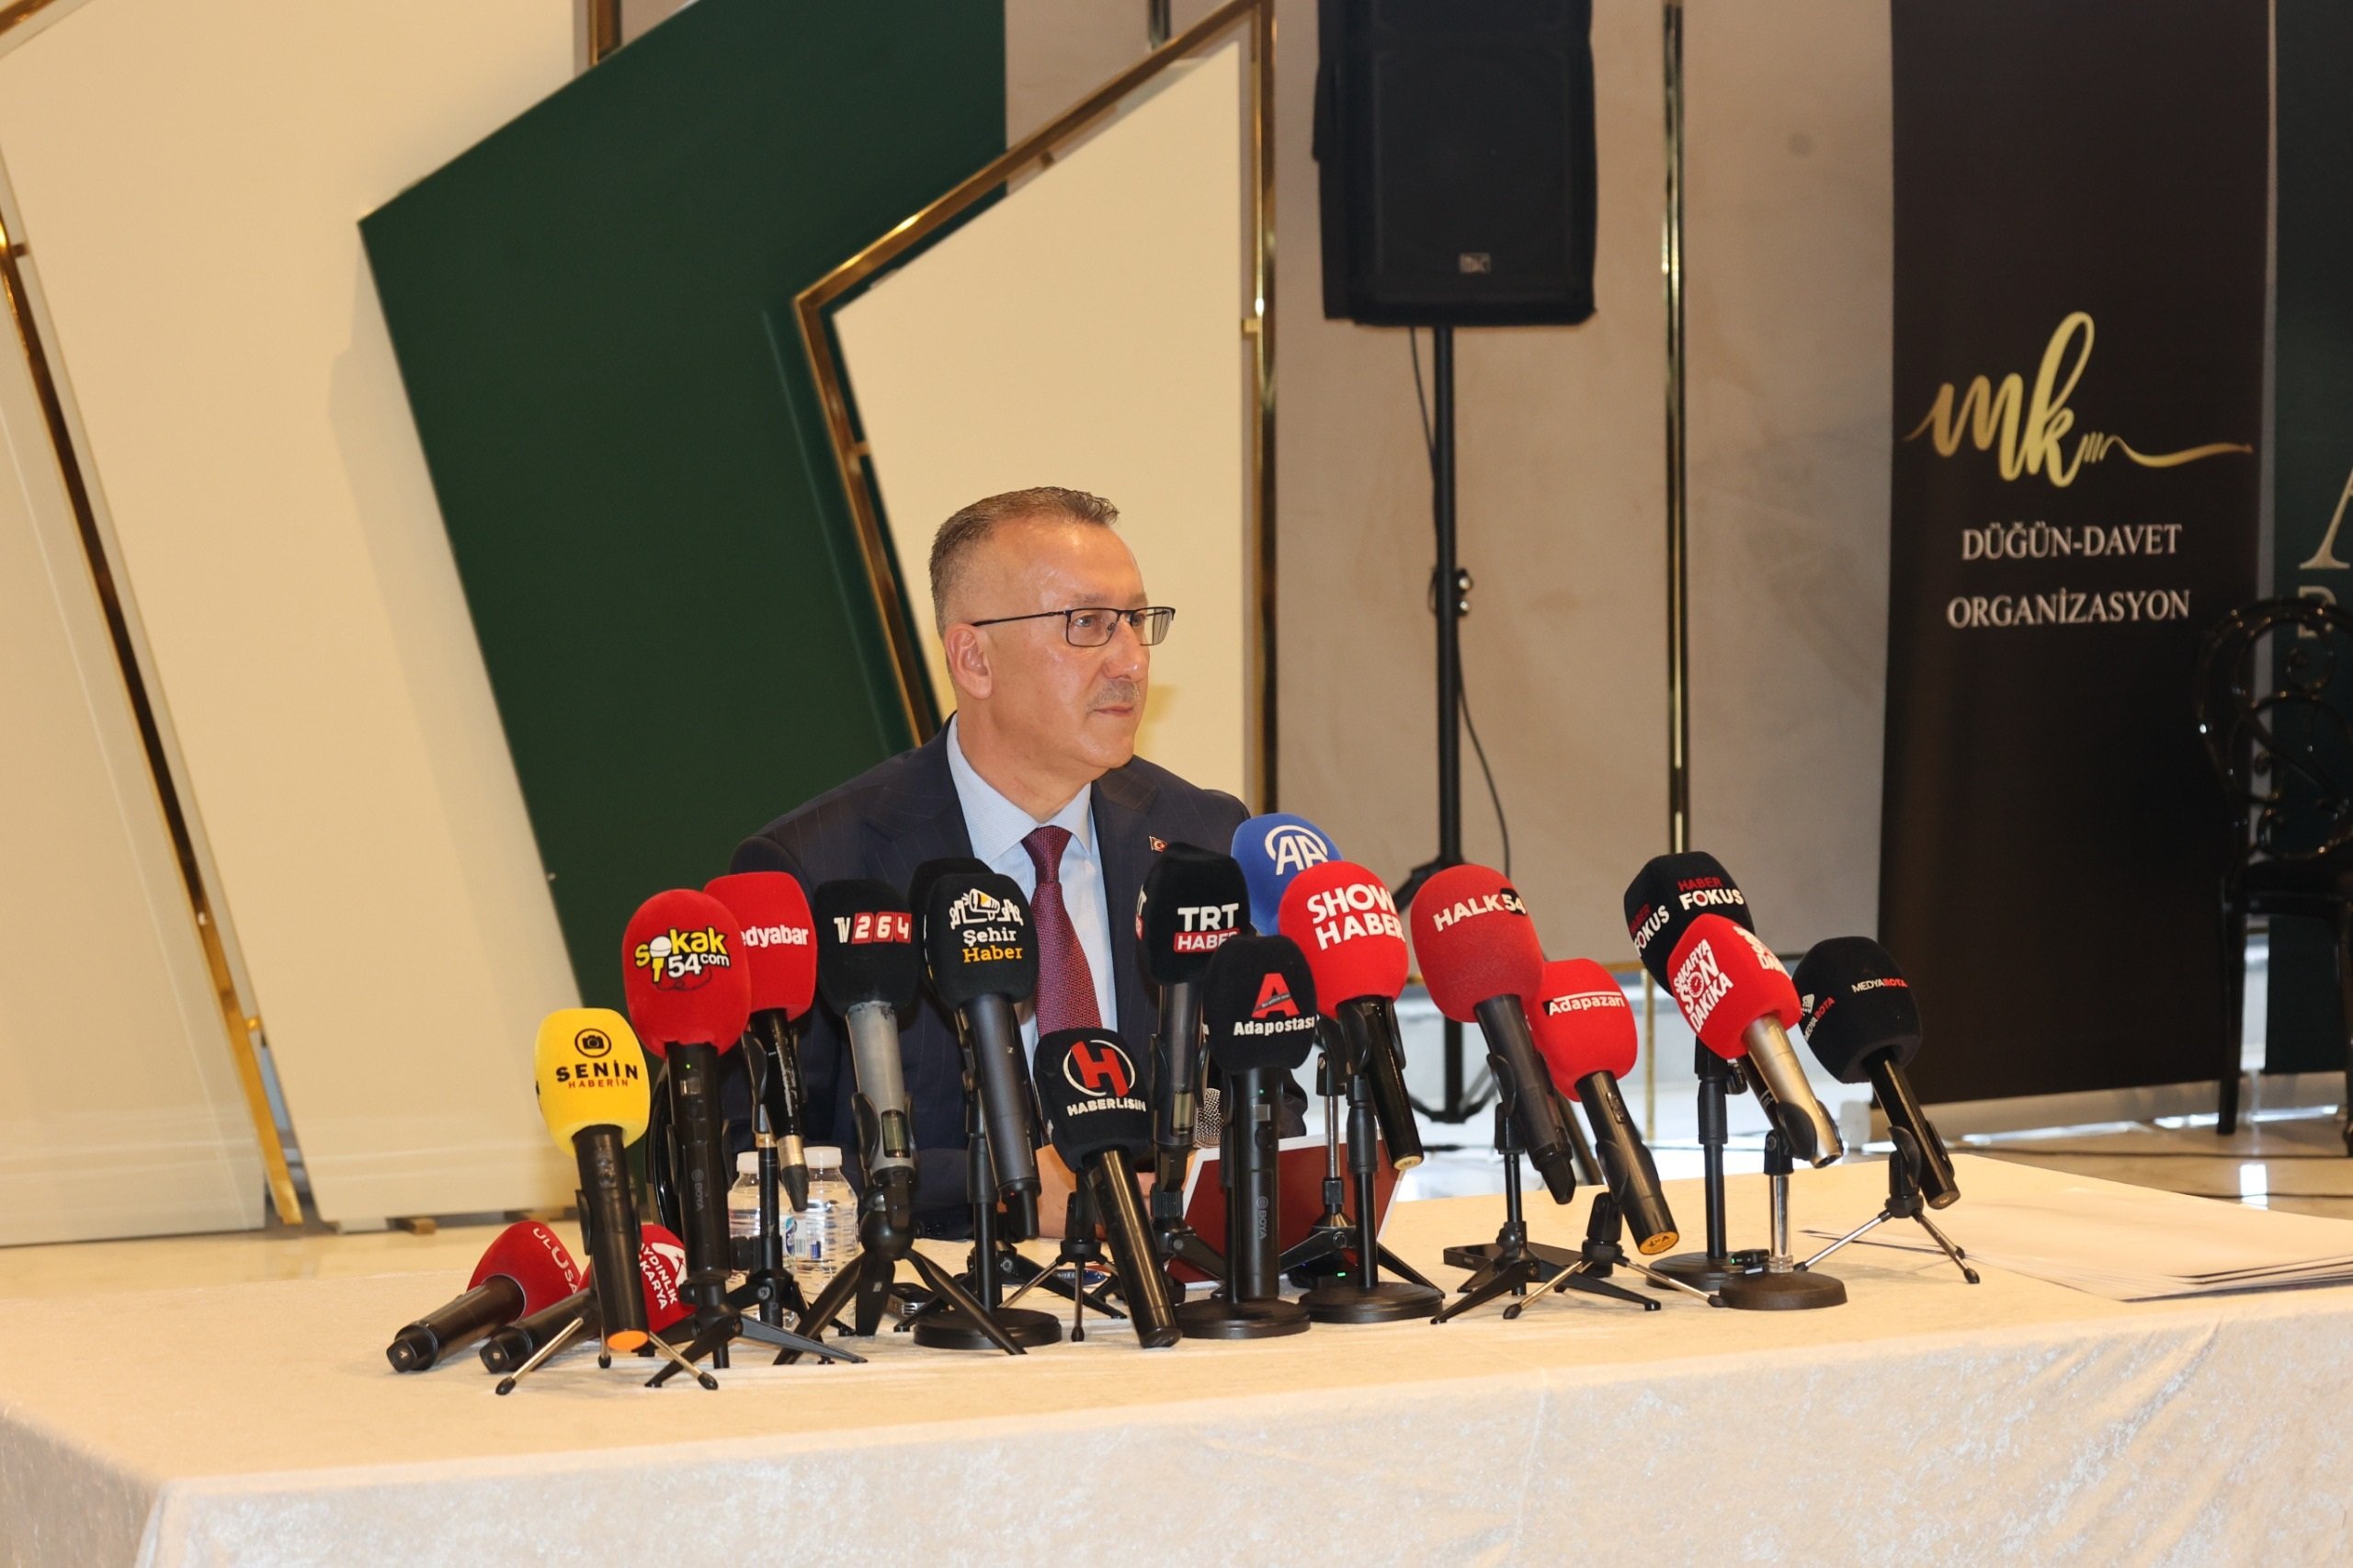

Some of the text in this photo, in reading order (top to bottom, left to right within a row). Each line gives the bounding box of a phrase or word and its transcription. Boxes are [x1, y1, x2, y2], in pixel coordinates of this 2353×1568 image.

[1961, 521, 2183, 561] DÜĞÜN-DAVET
[1946, 586, 2191, 630] ORGANİZASYON
[1275, 835, 1330, 876] AA
[1677, 877, 1723, 892] HABER
[1678, 888, 1745, 911] FOKUS
[1177, 903, 1240, 932] TRT
[1307, 883, 1399, 925] SHOW
[962, 926, 1017, 948] Şehir
[1177, 931, 1238, 951] HABE
[1314, 913, 1406, 950] HABER
[1634, 904, 1670, 958] FOKUS
[962, 945, 1023, 963] Haber
[1673, 938, 1711, 994] SAKARYA
[1680, 950, 1720, 1014] SON
[555, 1059, 639, 1083] SENİN
[1259, 1210, 1267, 1240] BOYA
[532, 1227, 578, 1295] ULUSA
[638, 1254, 668, 1311] KARYA
